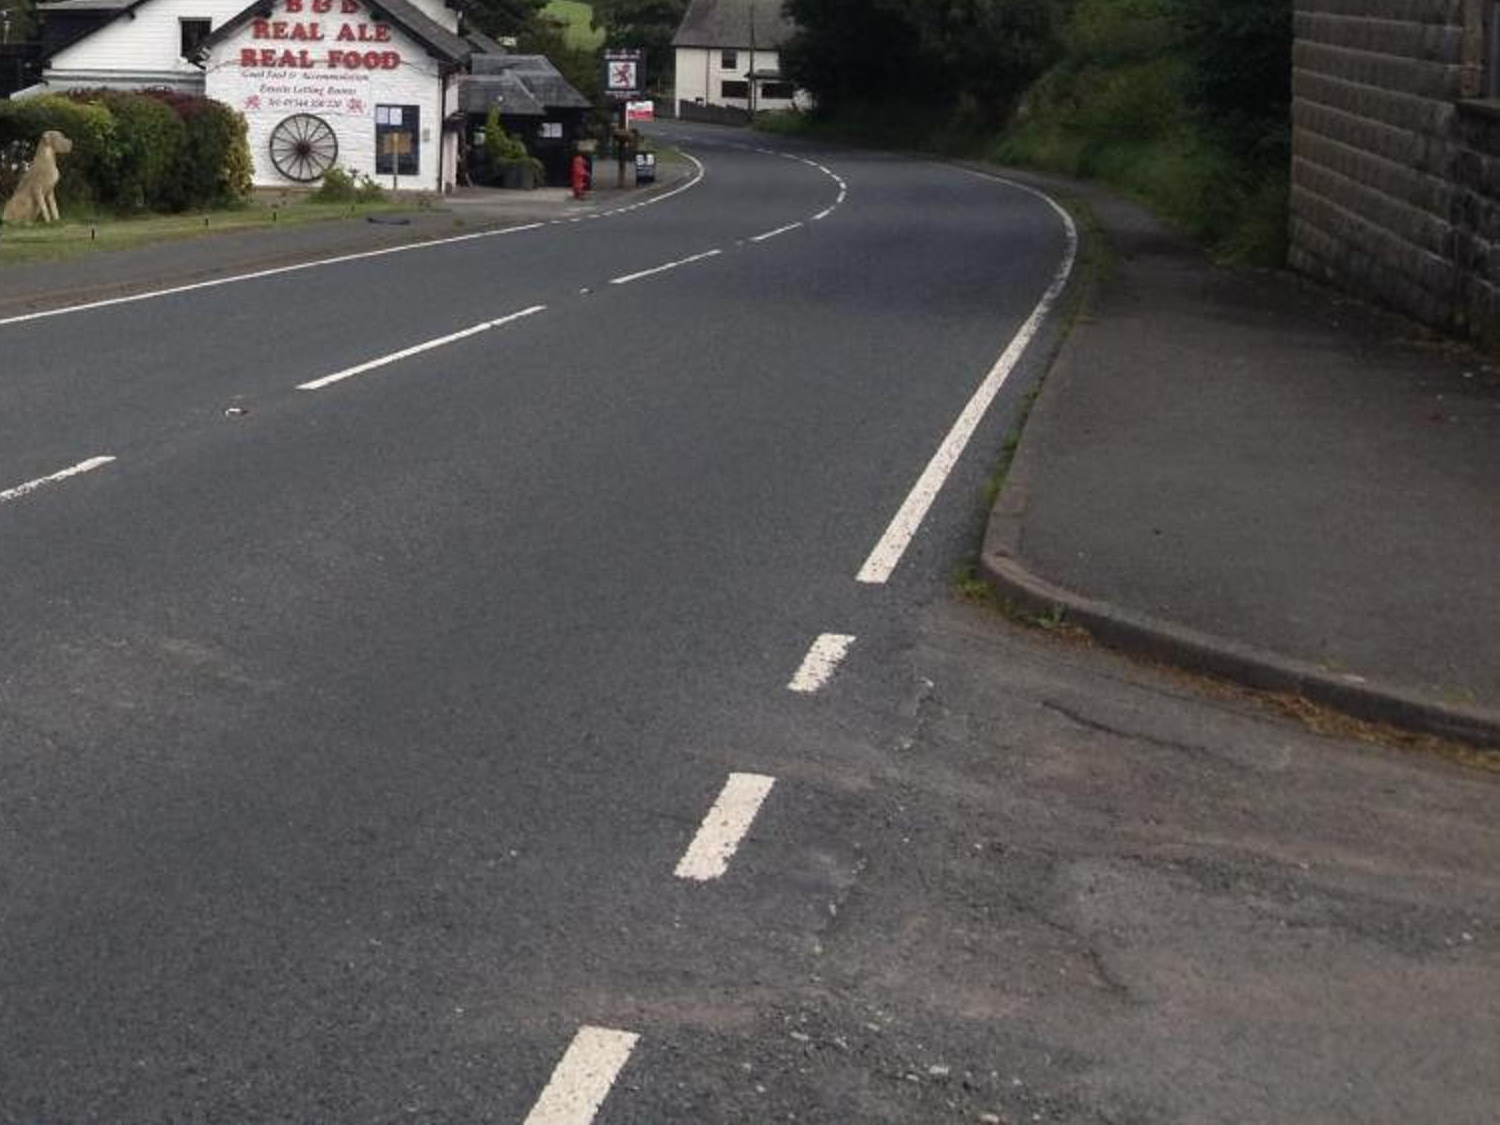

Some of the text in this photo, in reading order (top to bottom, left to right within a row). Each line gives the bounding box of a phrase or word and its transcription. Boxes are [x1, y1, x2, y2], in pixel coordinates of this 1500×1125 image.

[252, 19, 392, 42] REAL ALE
[240, 48, 402, 70] REAL FOOD
